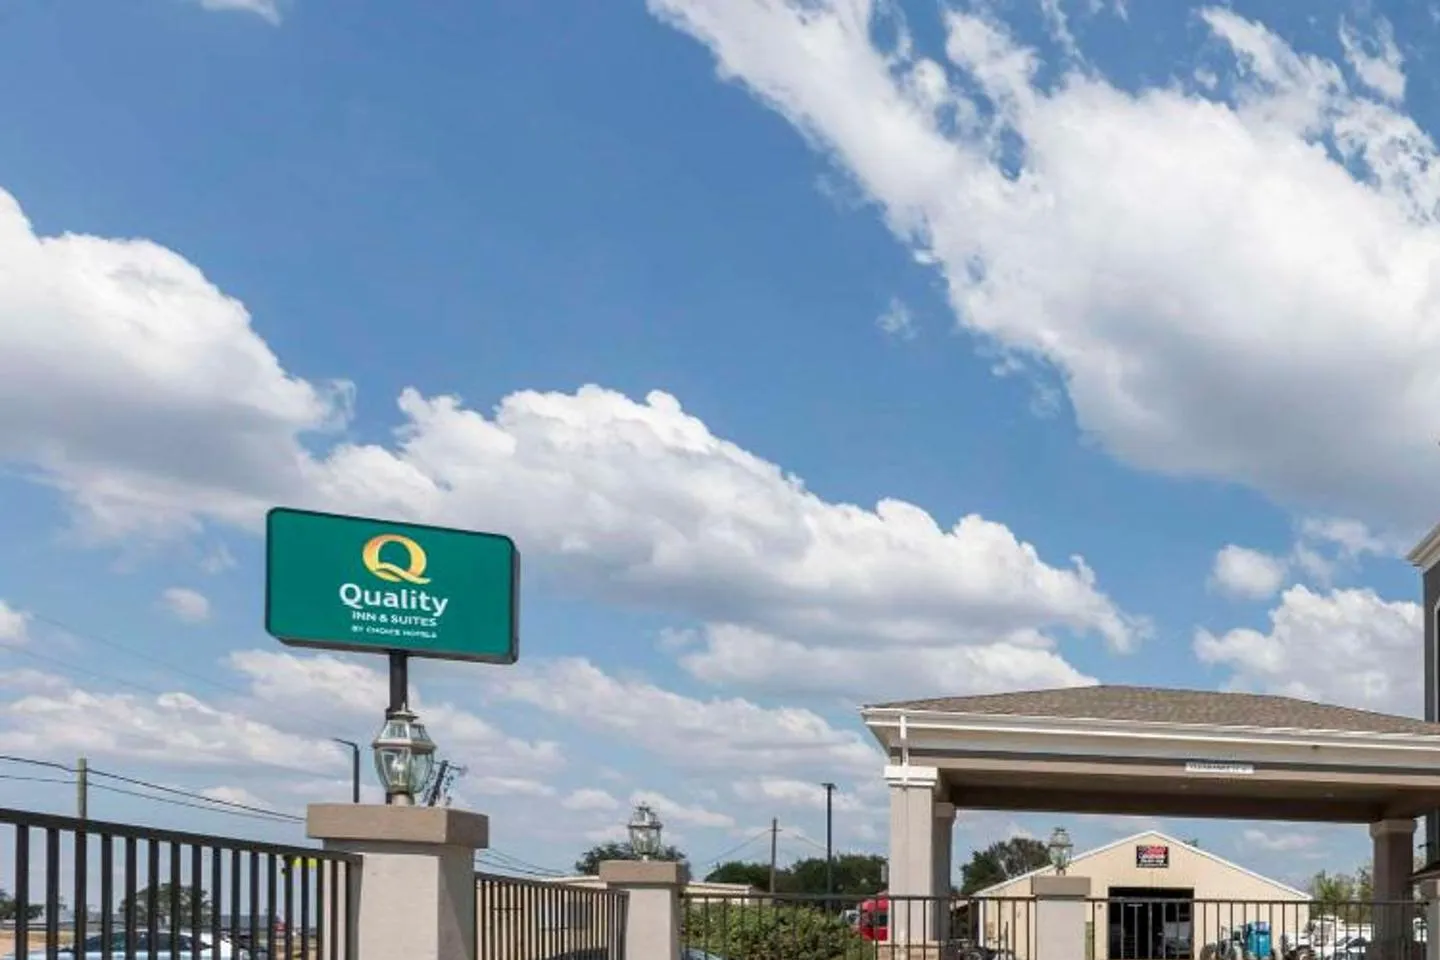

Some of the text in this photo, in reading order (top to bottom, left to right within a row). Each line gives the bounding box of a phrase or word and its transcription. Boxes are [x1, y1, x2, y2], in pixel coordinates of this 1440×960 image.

[362, 534, 432, 585] Q
[339, 583, 448, 617] Quality
[352, 611, 437, 627] INN & SUITES
